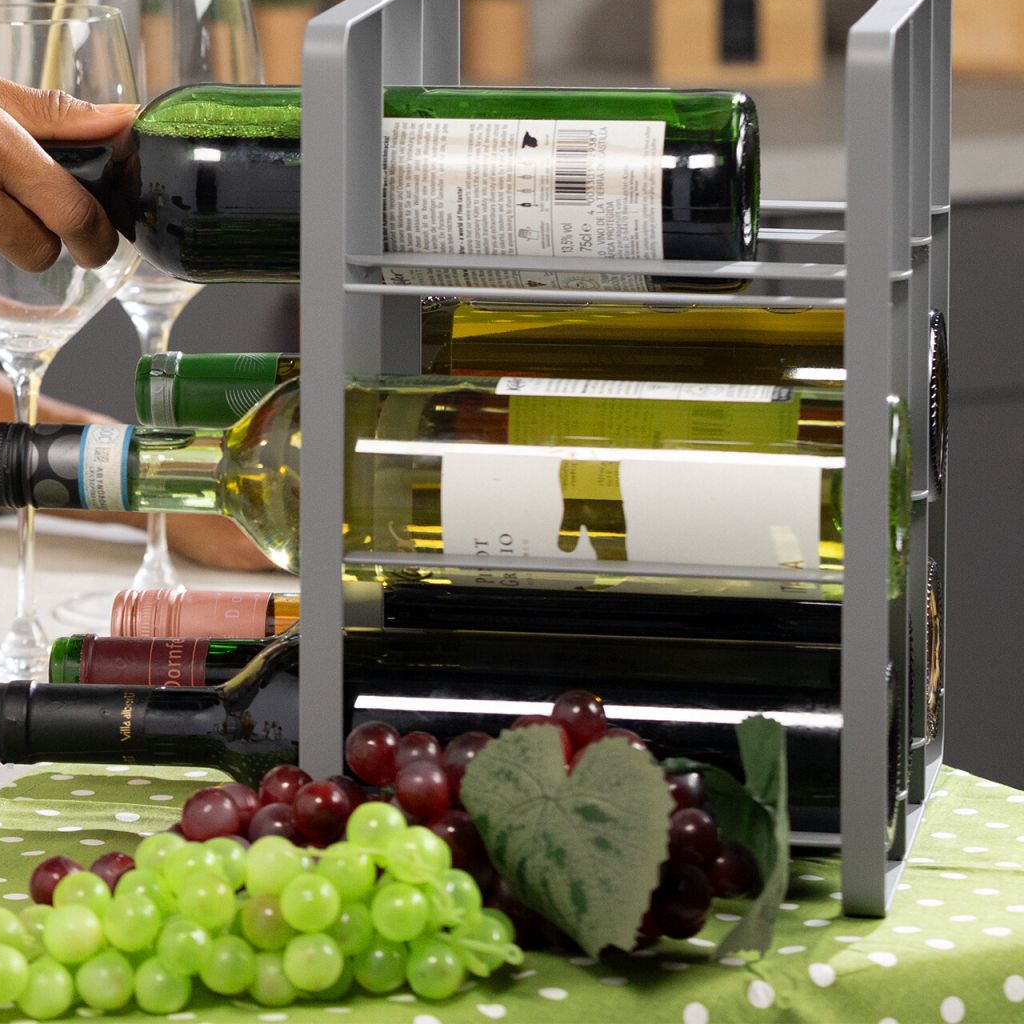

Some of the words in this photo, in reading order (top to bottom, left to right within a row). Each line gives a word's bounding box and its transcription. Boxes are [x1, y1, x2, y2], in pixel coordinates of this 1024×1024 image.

[595, 173, 605, 200] TIERRA
[596, 204, 604, 214] LA
[560, 223, 572, 233] vol
[597, 228, 606, 245] VINO
[561, 234, 574, 253] 13,5%
[579, 233, 592, 252] 75cl
[474, 538, 494, 584] PIOT
[499, 533, 519, 586] GRIO
